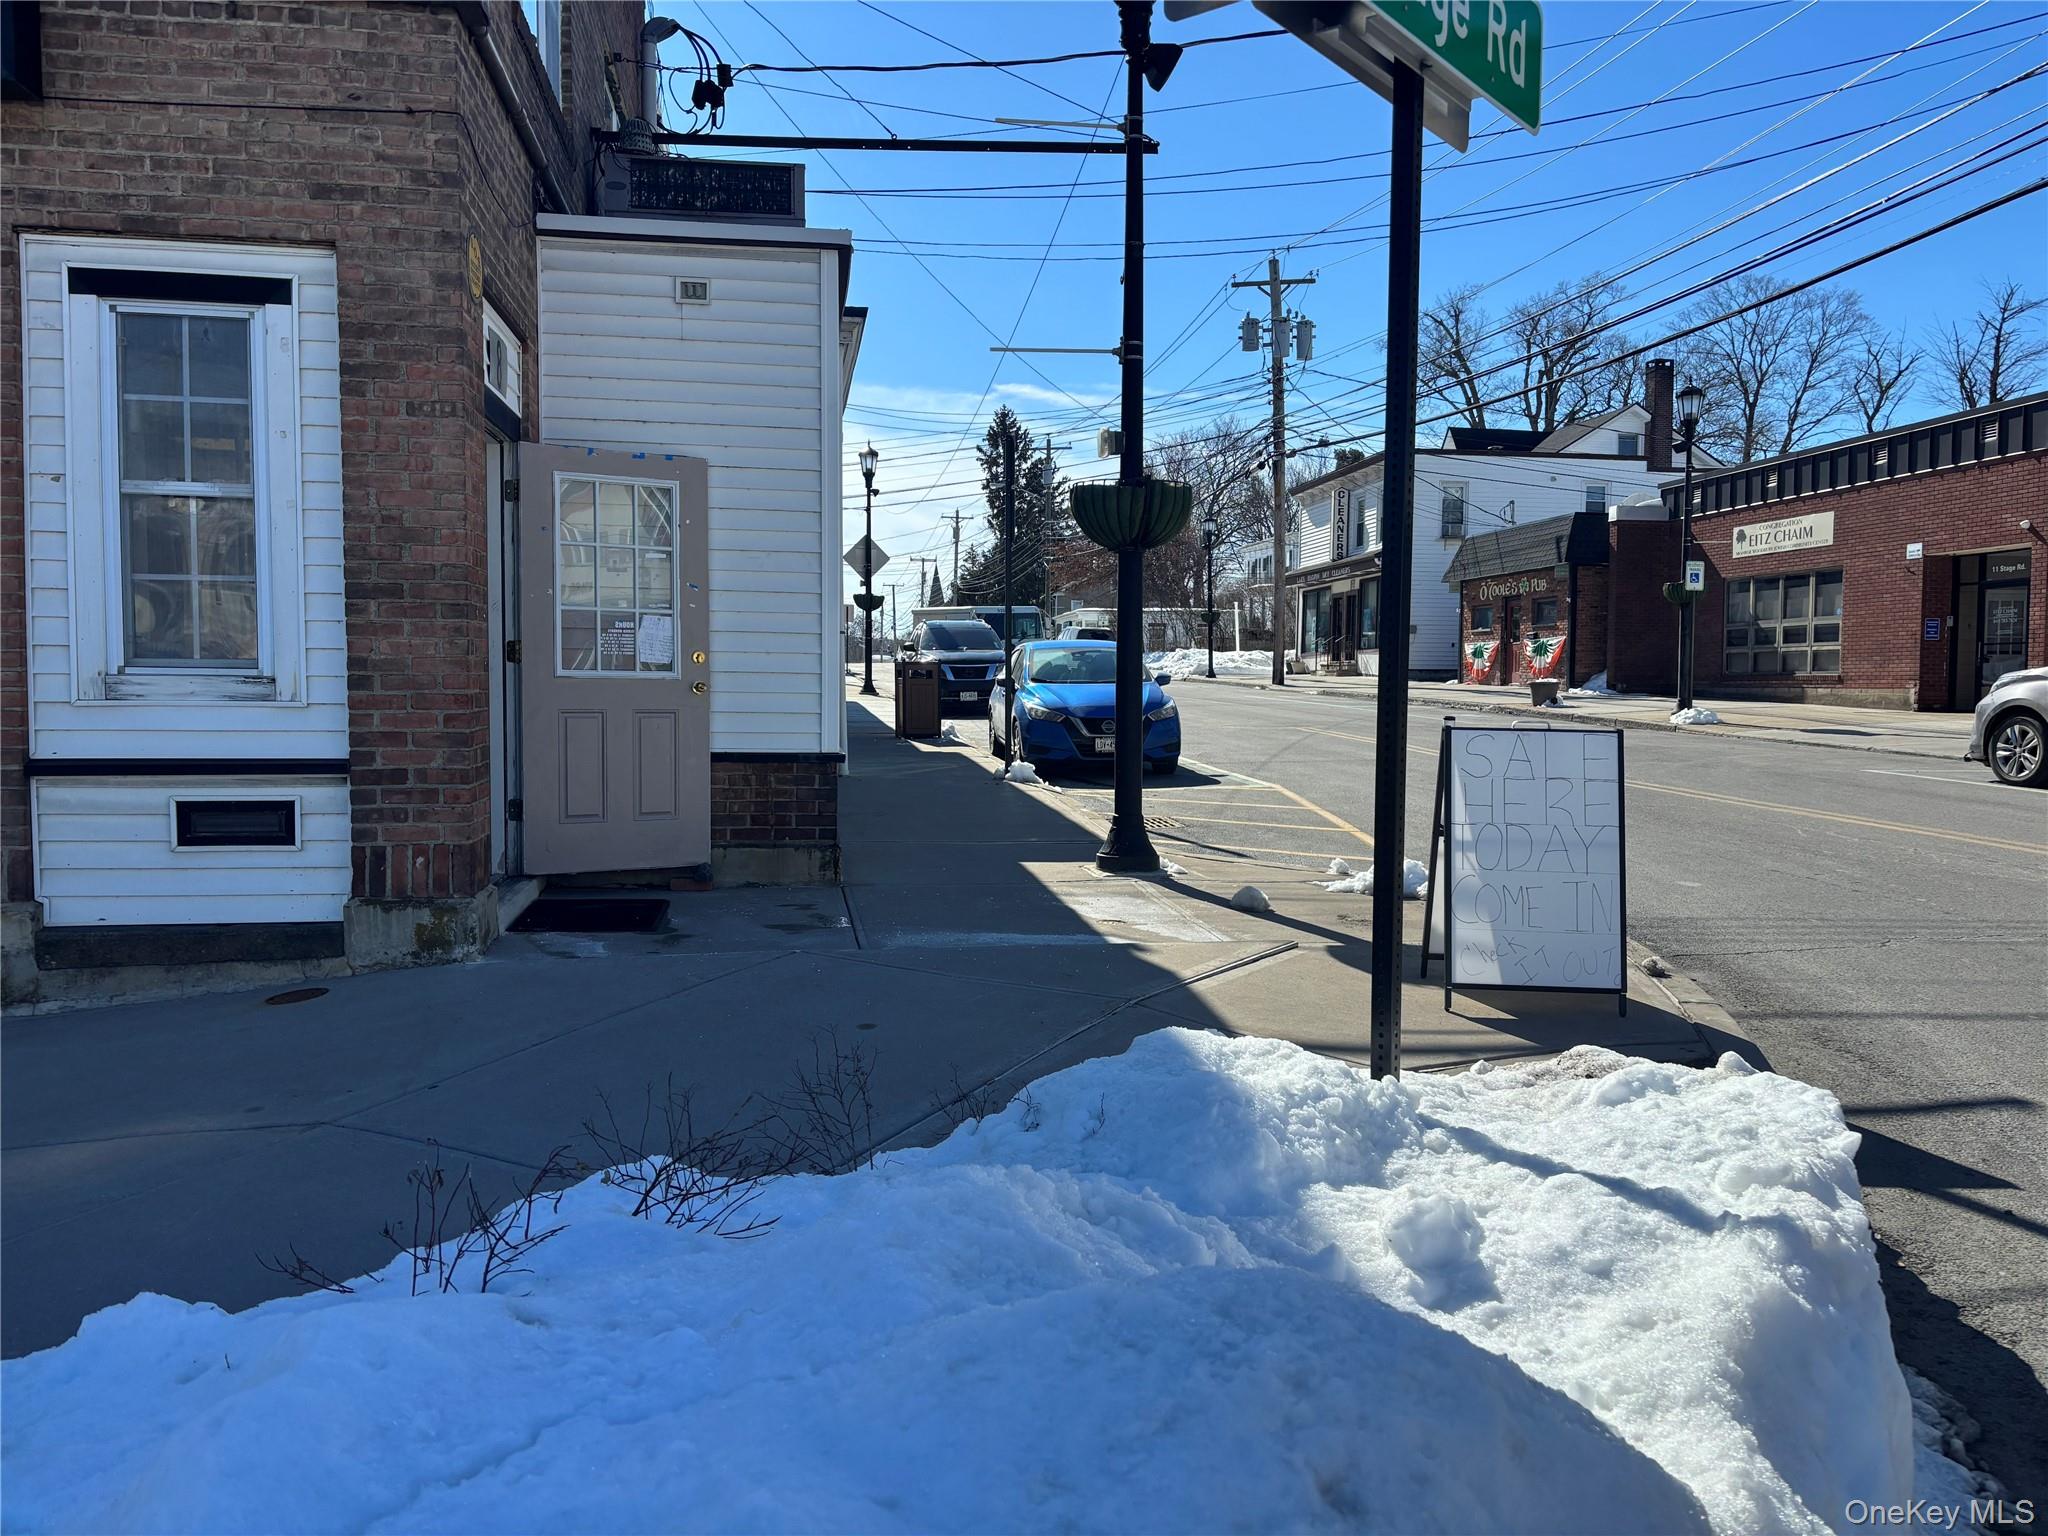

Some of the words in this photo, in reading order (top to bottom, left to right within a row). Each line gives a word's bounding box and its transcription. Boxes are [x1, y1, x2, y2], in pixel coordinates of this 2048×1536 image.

[1487, 0, 1527, 89] Rd
[1336, 490, 1345, 560] CLEANERS
[1748, 531, 1771, 547] EITZ
[1773, 525, 1813, 543] CHAIM
[1759, 518, 1803, 531] CONGREGATION
[1460, 733, 1619, 780] SALE
[1464, 777, 1619, 826] HERE
[1451, 823, 1607, 876] TODAY
[1451, 874, 1544, 928] COME
[1562, 880, 1613, 933] IN
